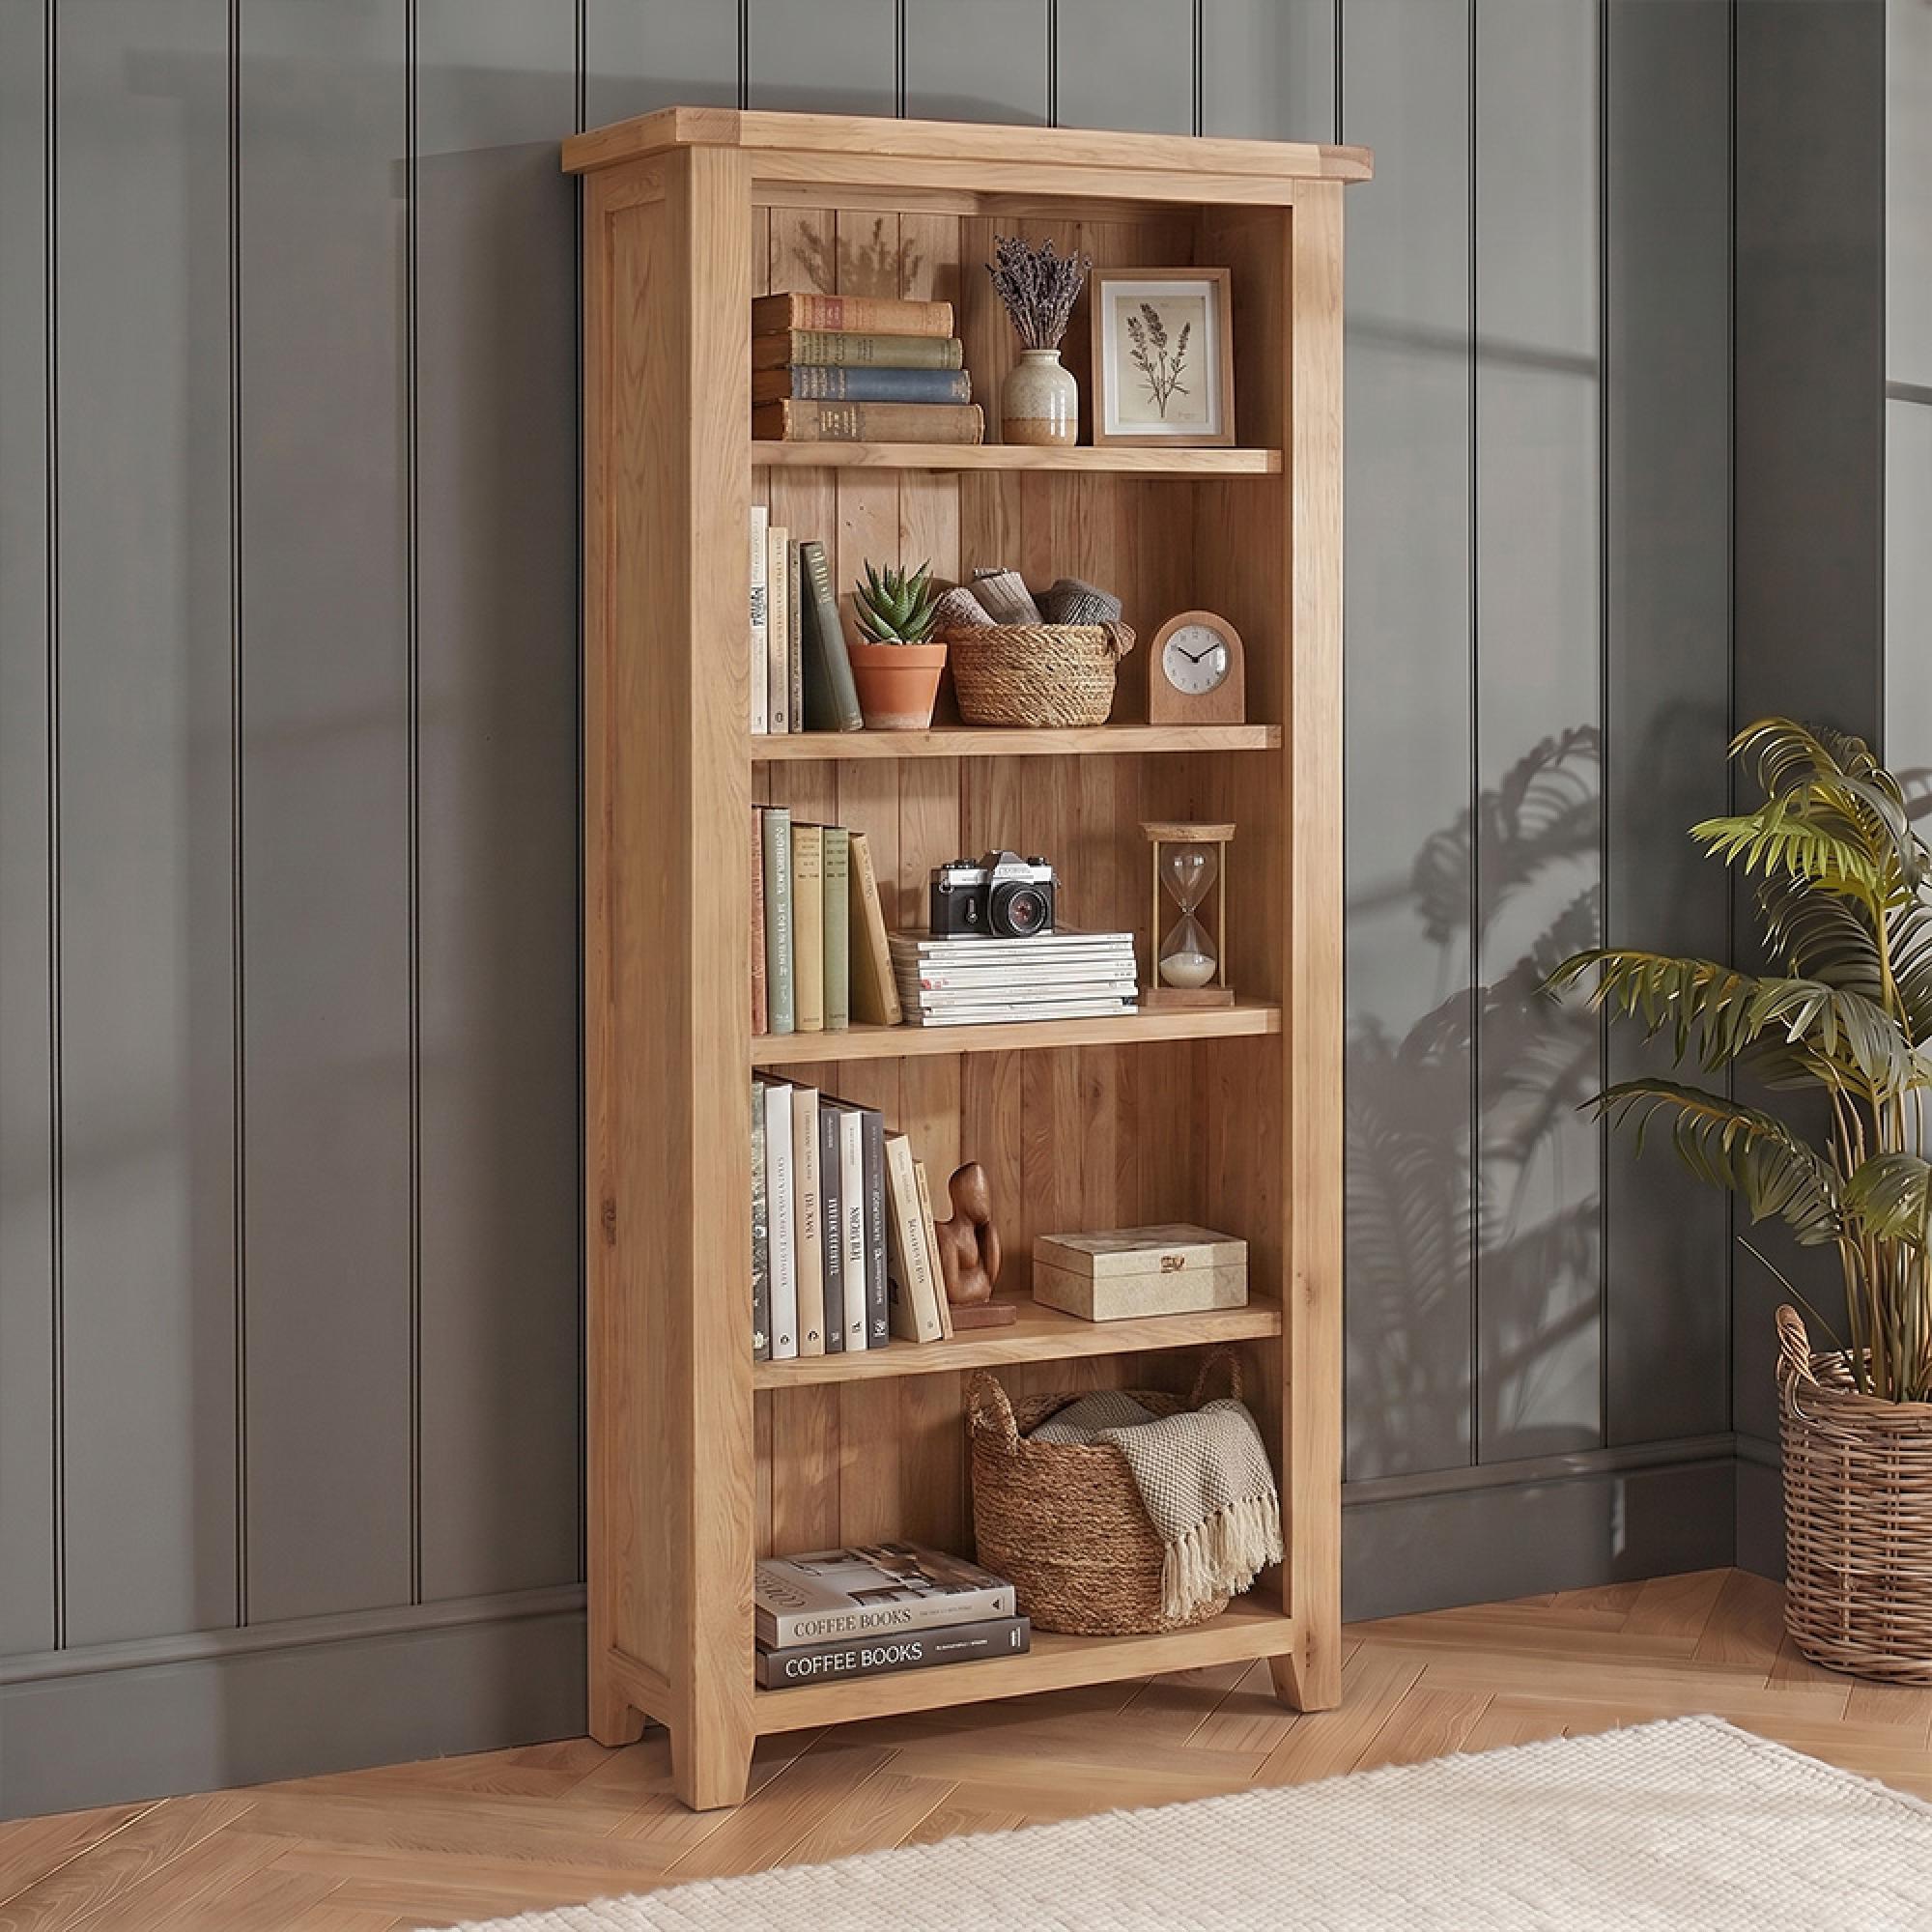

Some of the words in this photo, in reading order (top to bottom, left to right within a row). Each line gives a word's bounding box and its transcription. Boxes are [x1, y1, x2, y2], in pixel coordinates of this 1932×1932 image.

[793, 1614, 857, 1637] COFFEE
[860, 1607, 911, 1630] BOOKS
[785, 1651, 857, 1678] COFFEE
[861, 1641, 923, 1668] BOOKS
